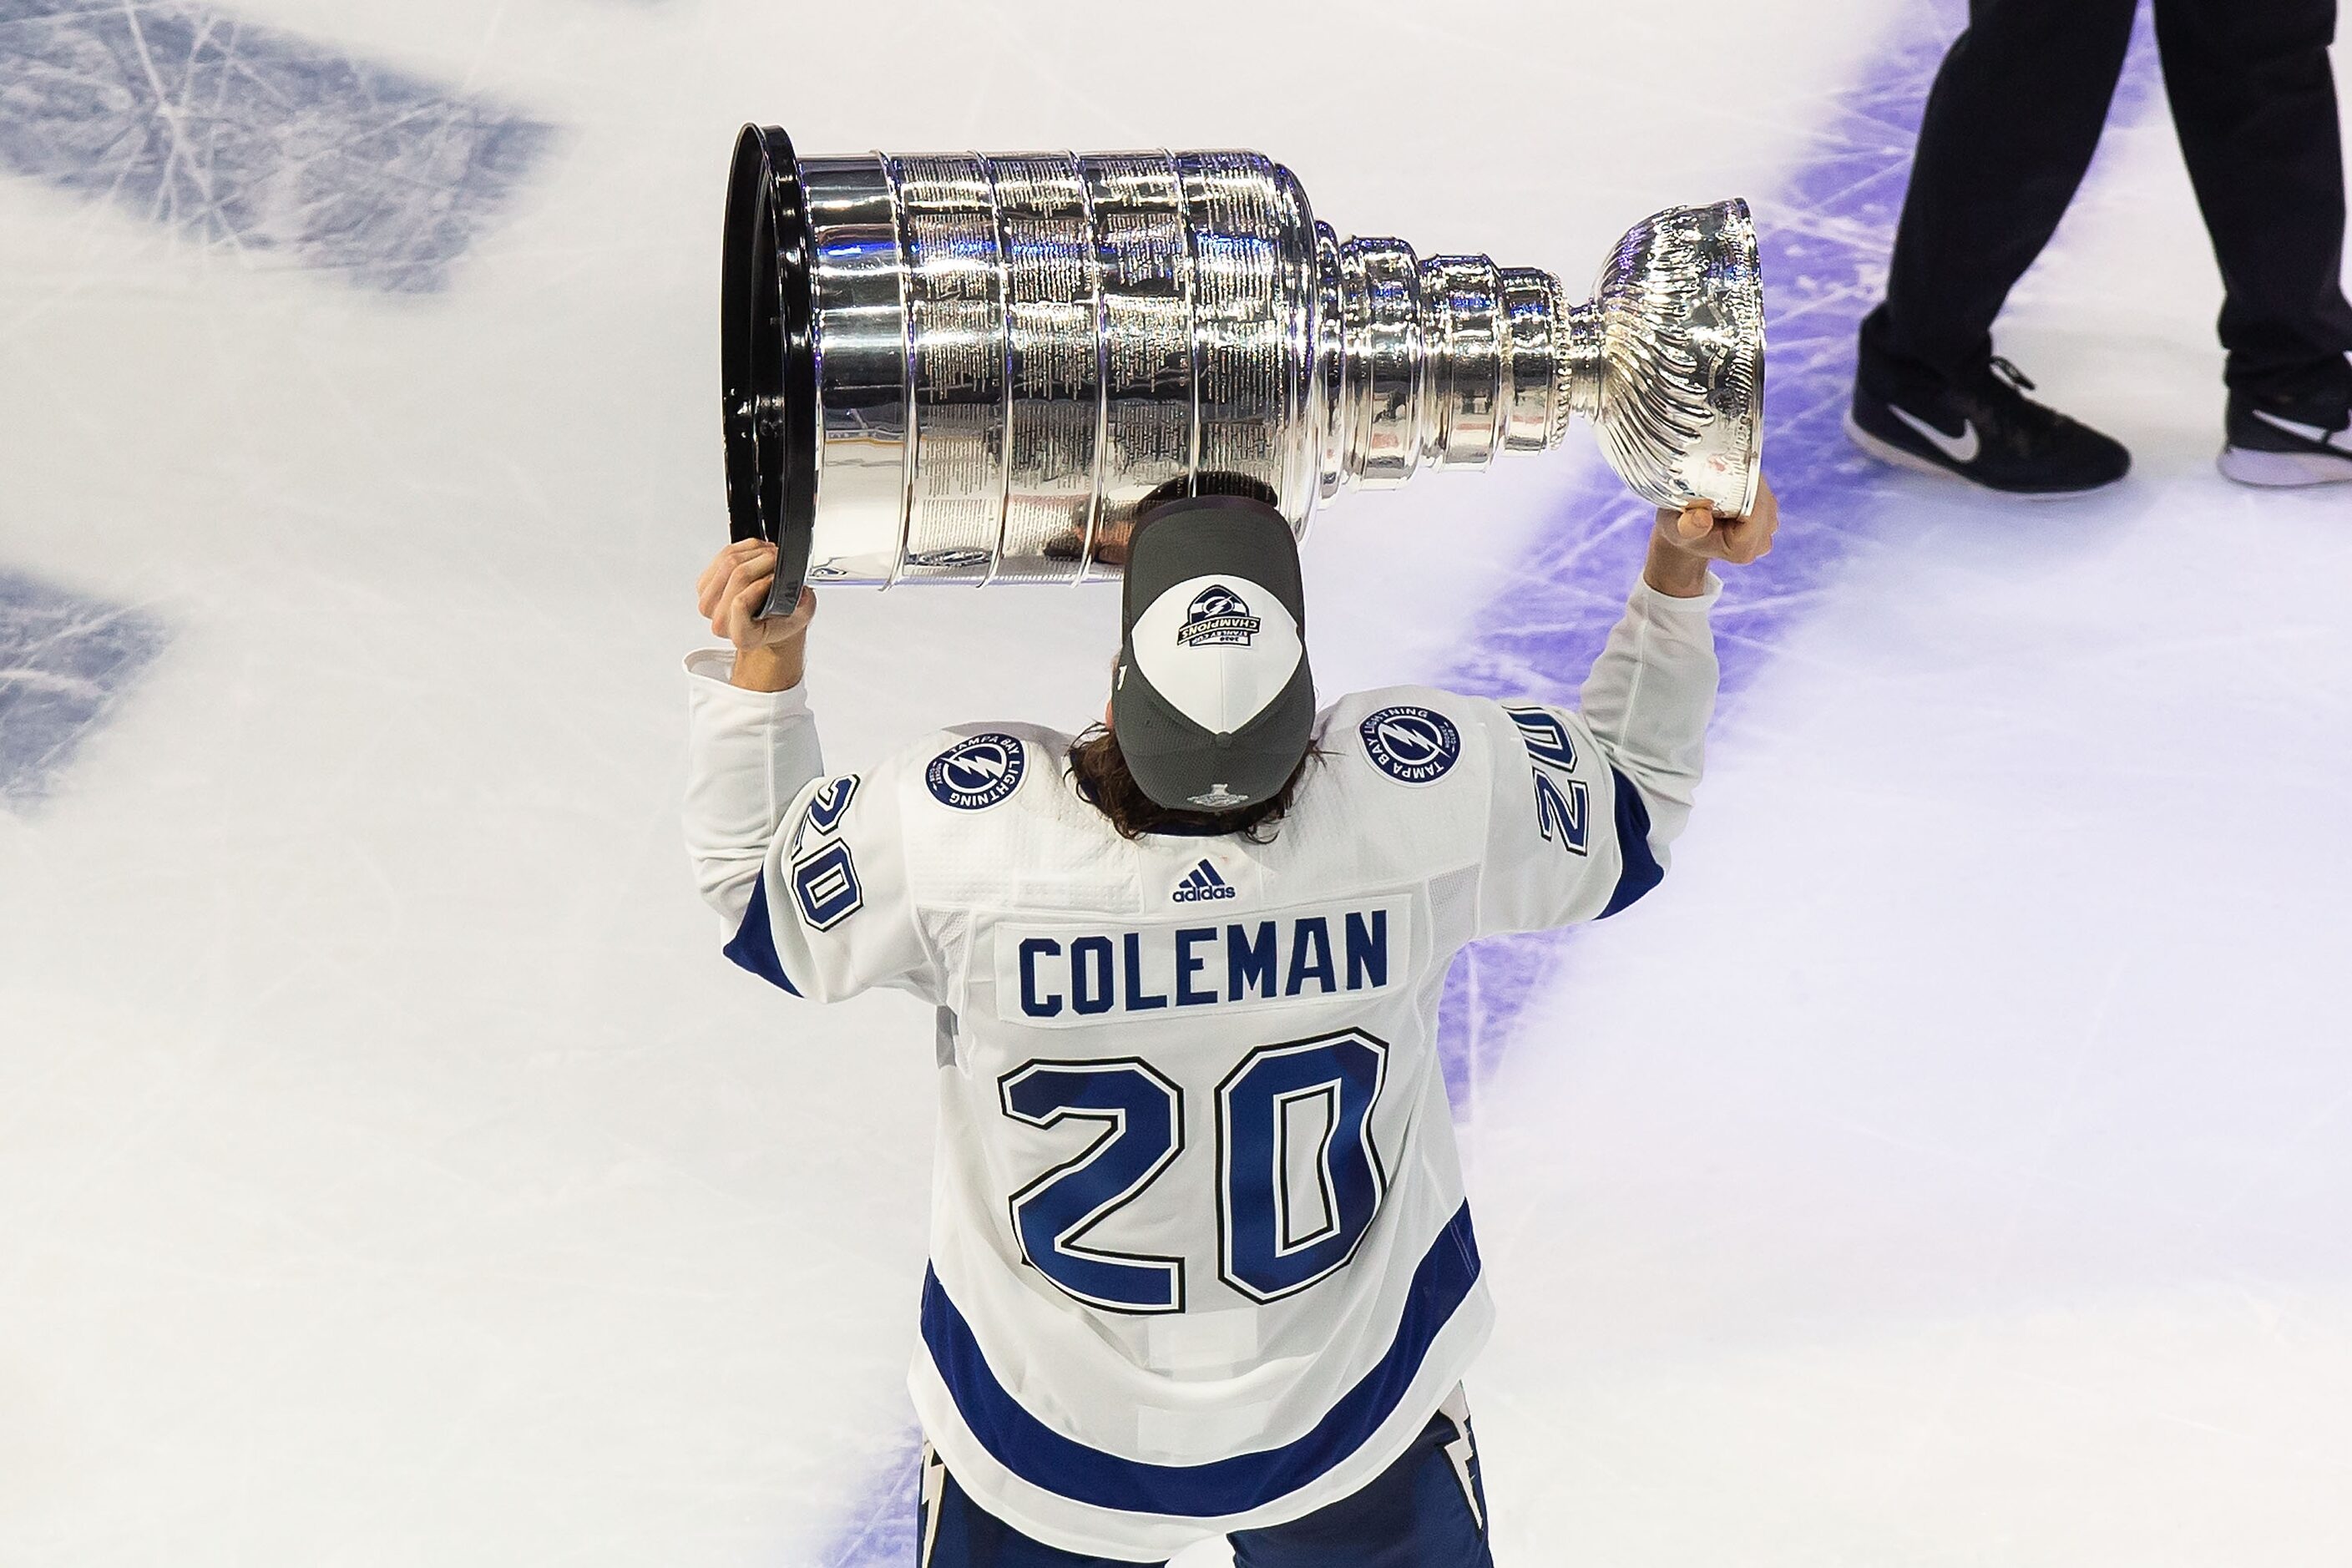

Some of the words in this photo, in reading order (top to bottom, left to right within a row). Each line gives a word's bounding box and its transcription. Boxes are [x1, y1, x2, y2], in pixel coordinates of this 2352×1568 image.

[1181, 619, 1257, 638] CHAMPIONS
[1364, 708, 1428, 734] LIGHTNING
[949, 735, 999, 753] TAMPA
[1000, 738, 1019, 755] BAY
[1367, 738, 1390, 766] BAY
[1393, 761, 1444, 779] TAMPA
[949, 761, 1020, 807] LIGHTNING
[1172, 885, 1236, 903] adidas
[1019, 909, 1388, 1018] COLEMAN
[997, 1026, 1390, 1316] 20
